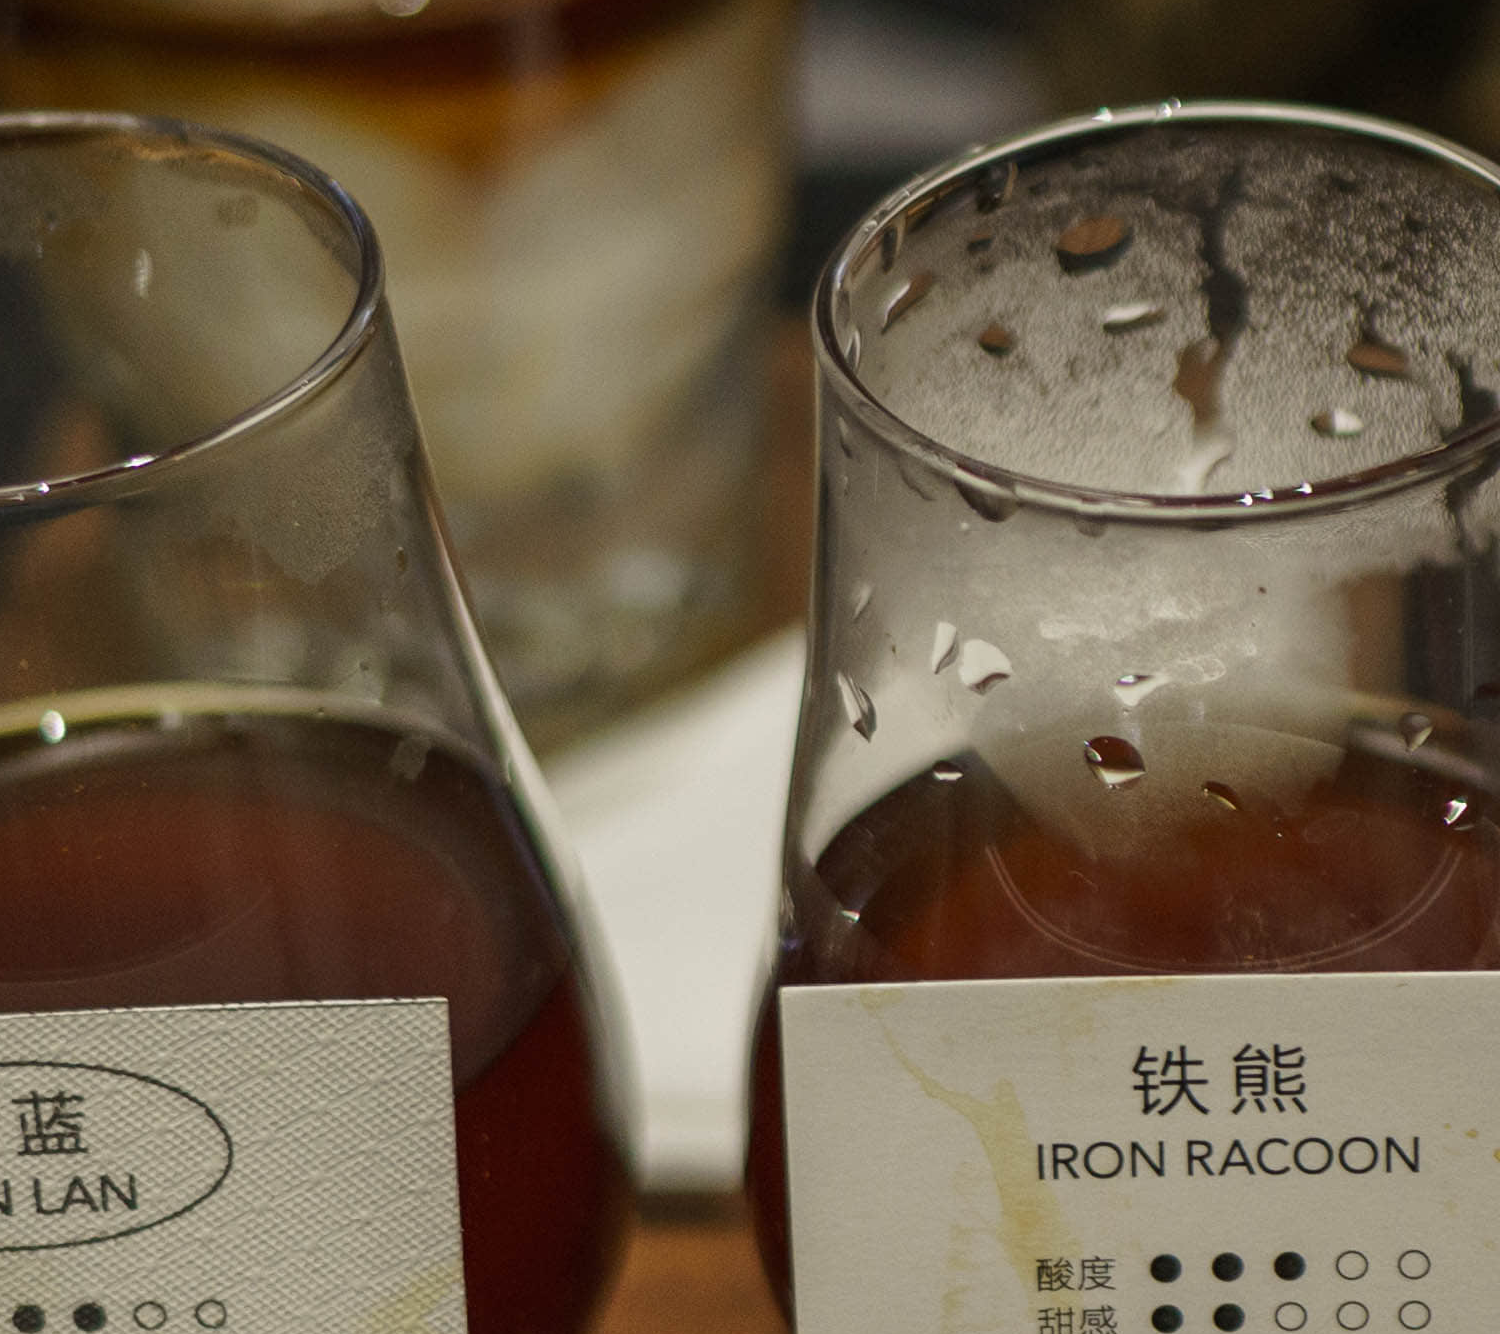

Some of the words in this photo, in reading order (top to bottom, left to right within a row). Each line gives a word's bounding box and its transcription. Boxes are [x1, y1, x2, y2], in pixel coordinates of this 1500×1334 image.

[1131, 1043, 1308, 1117] 铁熊
[1036, 1140, 1166, 1181] IRON
[1186, 1135, 1420, 1177] RACOON
[31, 1173, 139, 1217] LAN
[1035, 1256, 1114, 1293] 酸度
